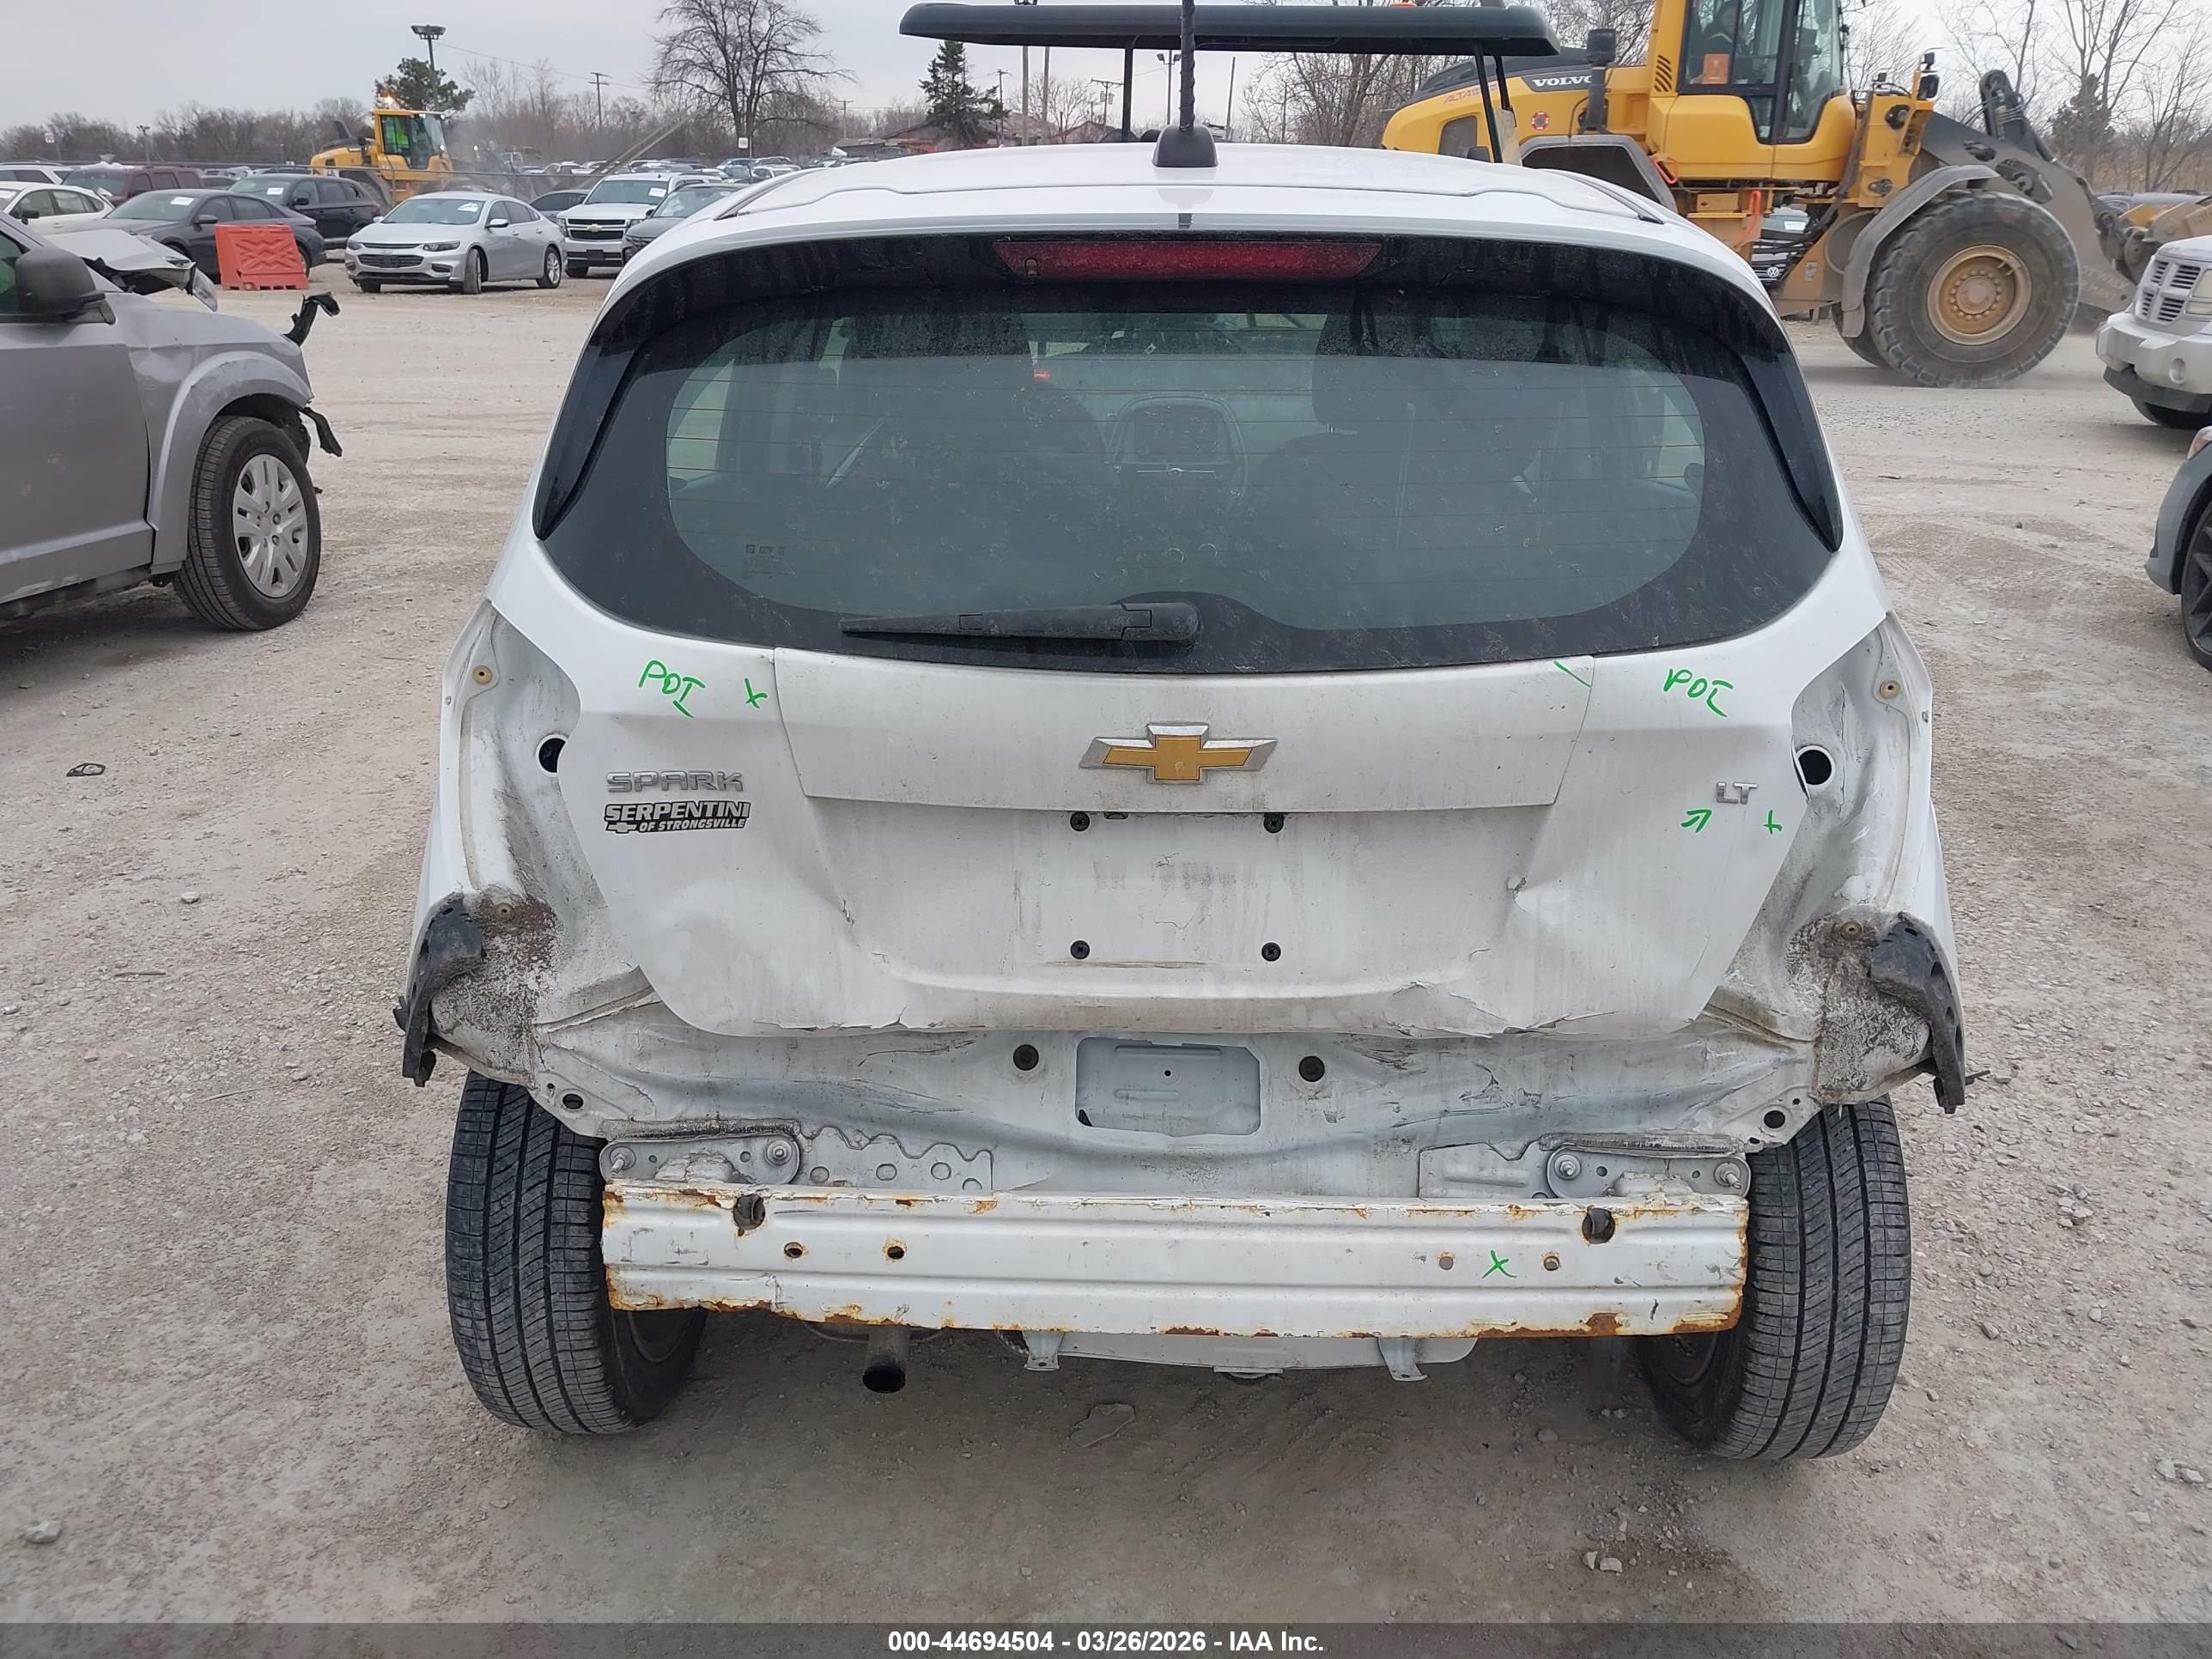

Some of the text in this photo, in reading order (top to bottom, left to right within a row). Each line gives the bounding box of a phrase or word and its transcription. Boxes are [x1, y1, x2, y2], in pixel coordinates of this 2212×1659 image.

[605, 771, 744, 793] SPARK
[1715, 781, 1759, 805] LT
[605, 801, 751, 822] SERPENTINI
[639, 818, 746, 833] OF STRONGSVILLE
